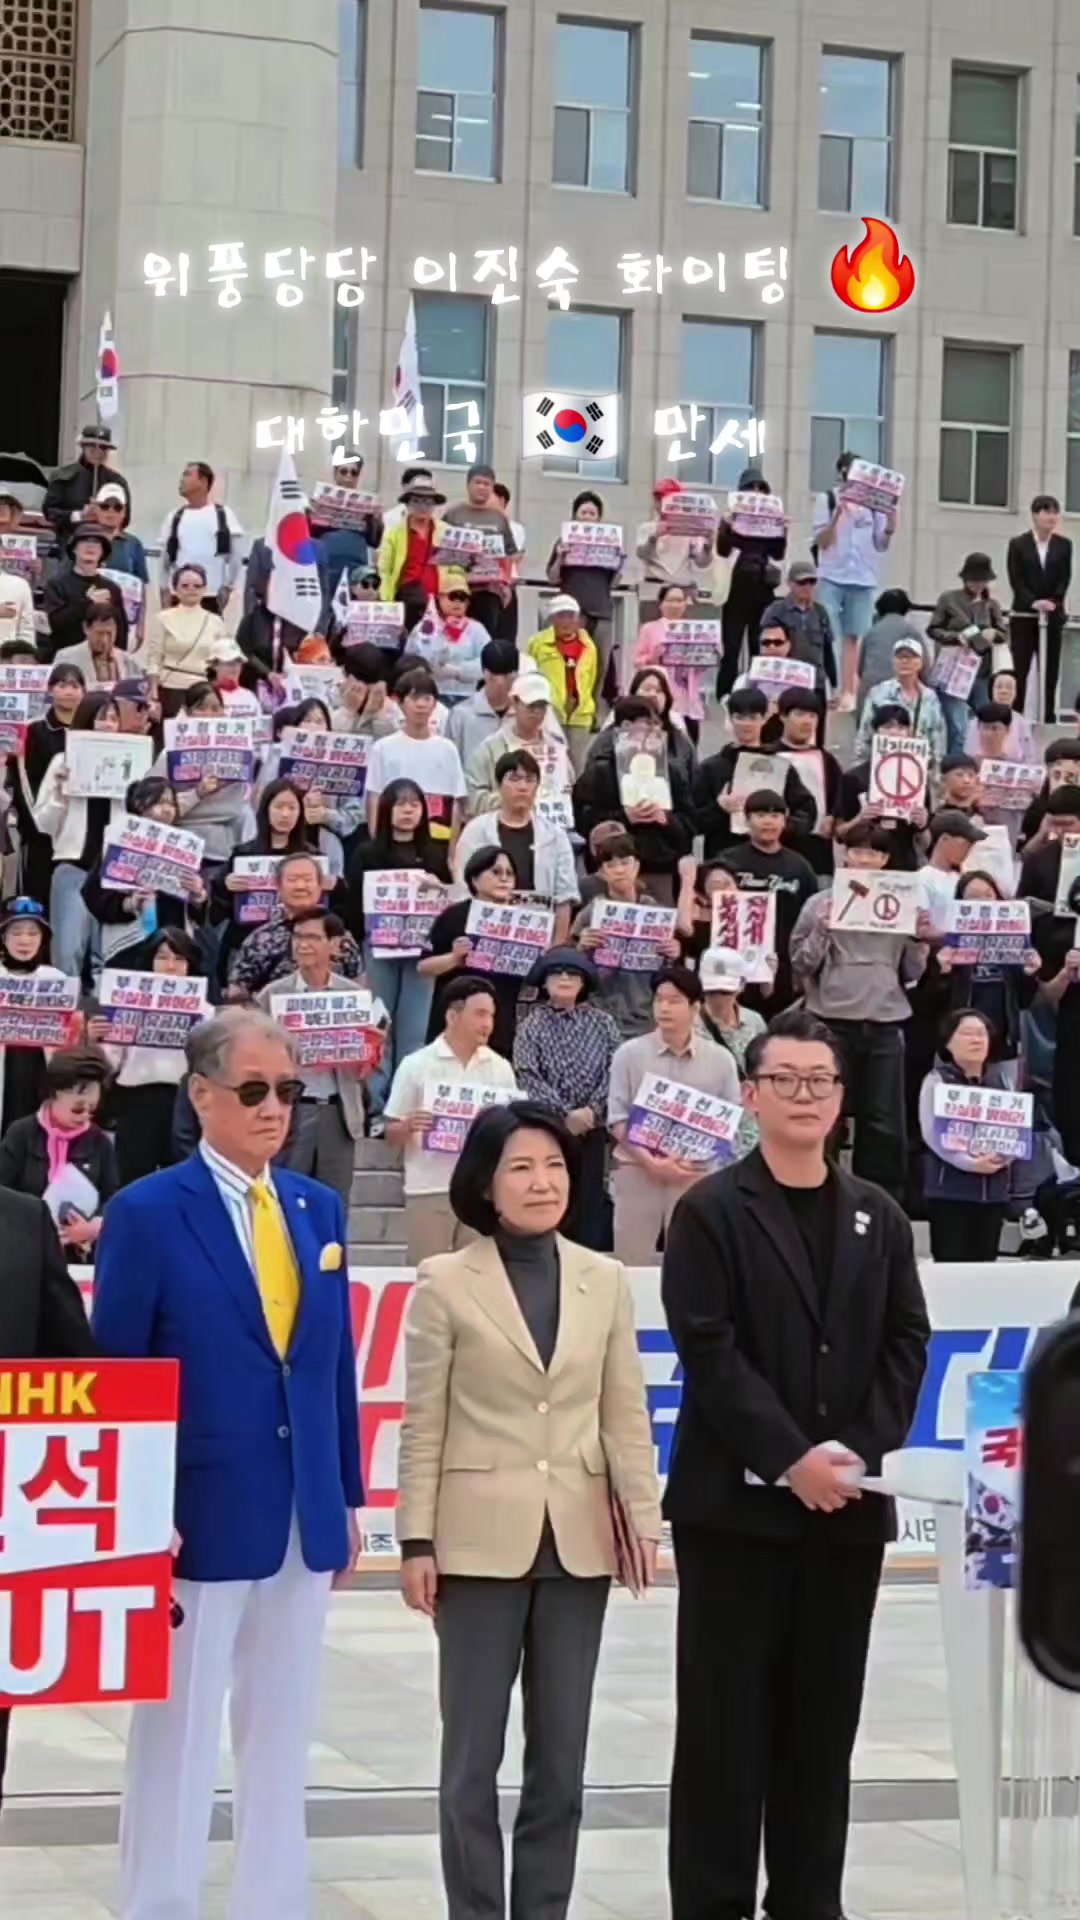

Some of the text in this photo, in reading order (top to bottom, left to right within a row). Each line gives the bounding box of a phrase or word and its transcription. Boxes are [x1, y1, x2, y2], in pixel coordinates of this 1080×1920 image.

[117, 975, 198, 994] 부정선거
[654, 1081, 734, 1118] 부정선거
[948, 1090, 1024, 1108] 부정선거
[0, 1428, 120, 1553] 석
